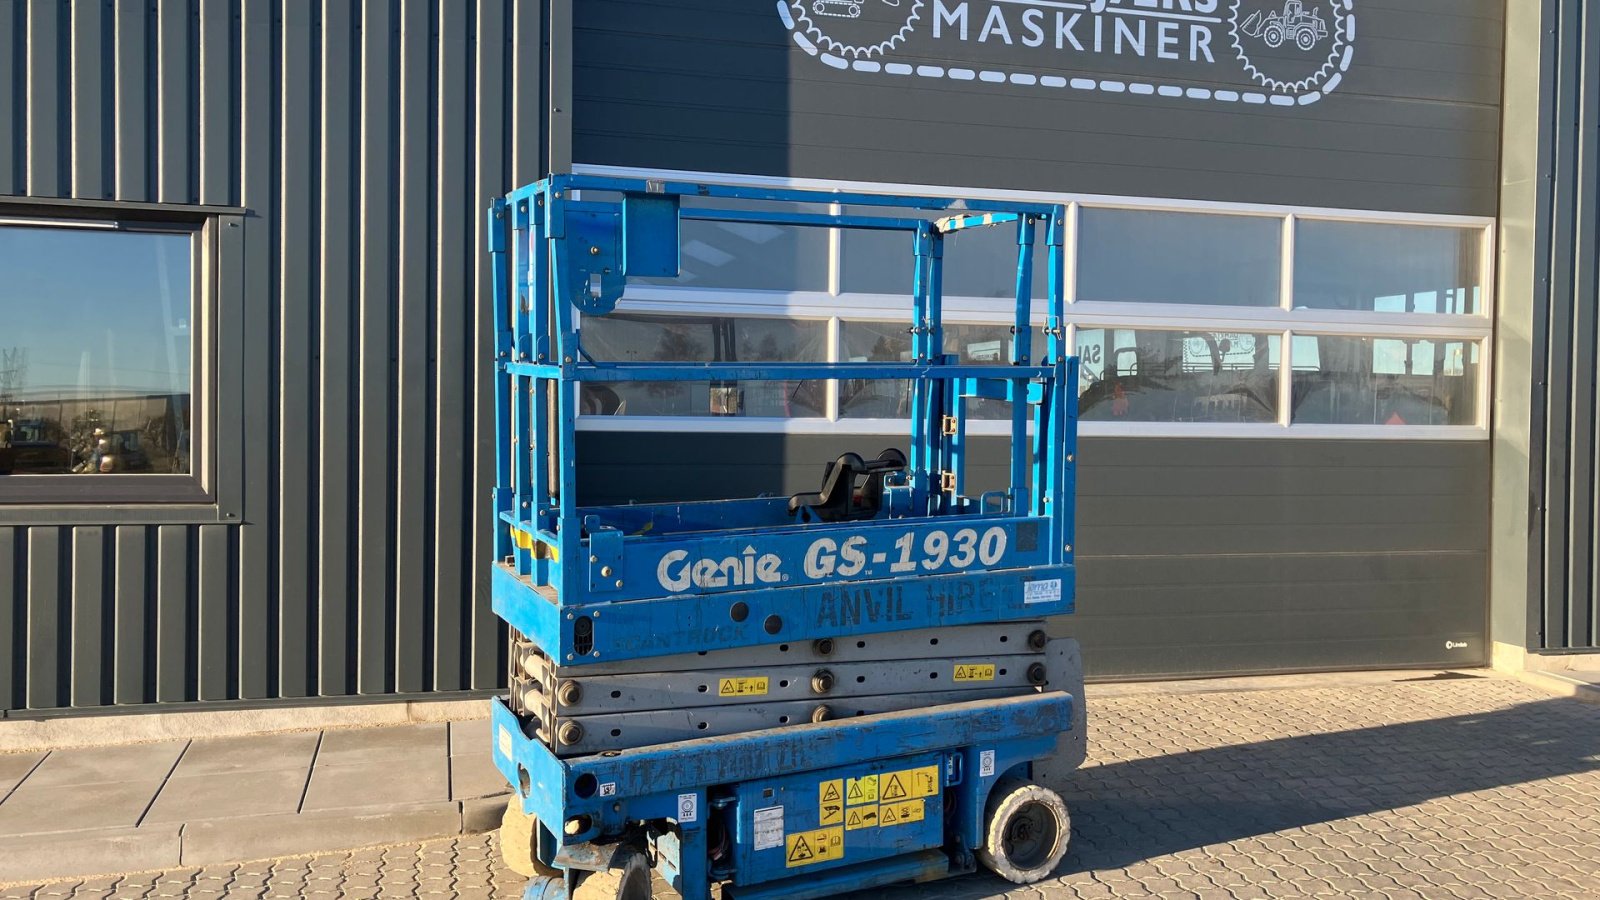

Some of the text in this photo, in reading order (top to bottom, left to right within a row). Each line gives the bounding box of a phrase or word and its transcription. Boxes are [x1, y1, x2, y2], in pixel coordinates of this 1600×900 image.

[931, 2, 1215, 63] MASKINER
[804, 527, 1007, 579] GS-1930
[816, 585, 914, 629] ANVIL
